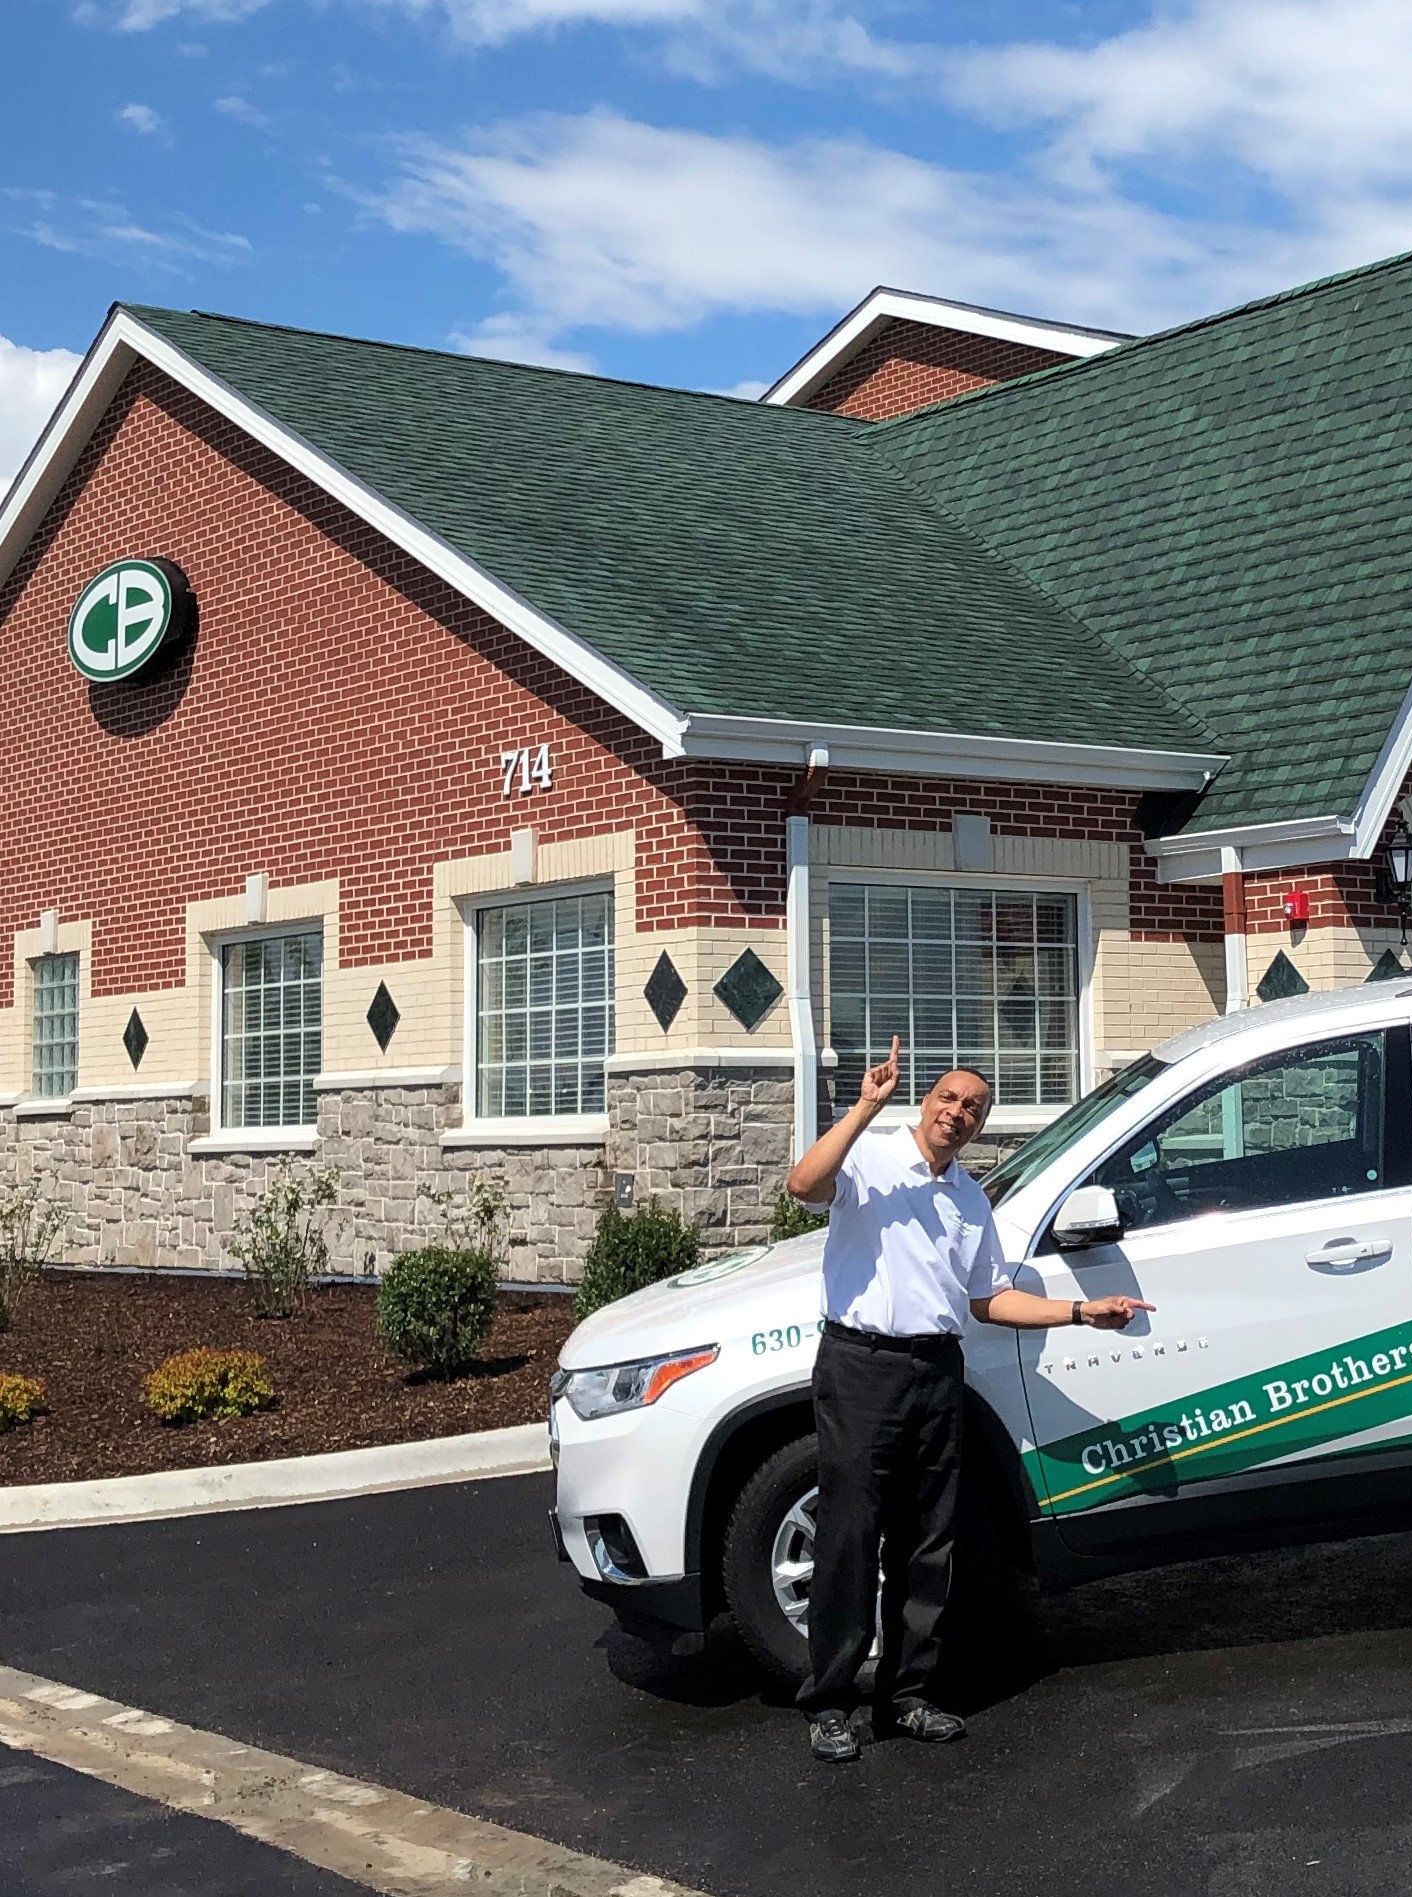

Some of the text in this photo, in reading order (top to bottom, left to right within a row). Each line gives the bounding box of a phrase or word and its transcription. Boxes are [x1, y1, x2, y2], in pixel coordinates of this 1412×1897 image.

[72, 569, 165, 671] CB
[500, 743, 553, 796] 714
[1081, 1399, 1257, 1475] Christian
